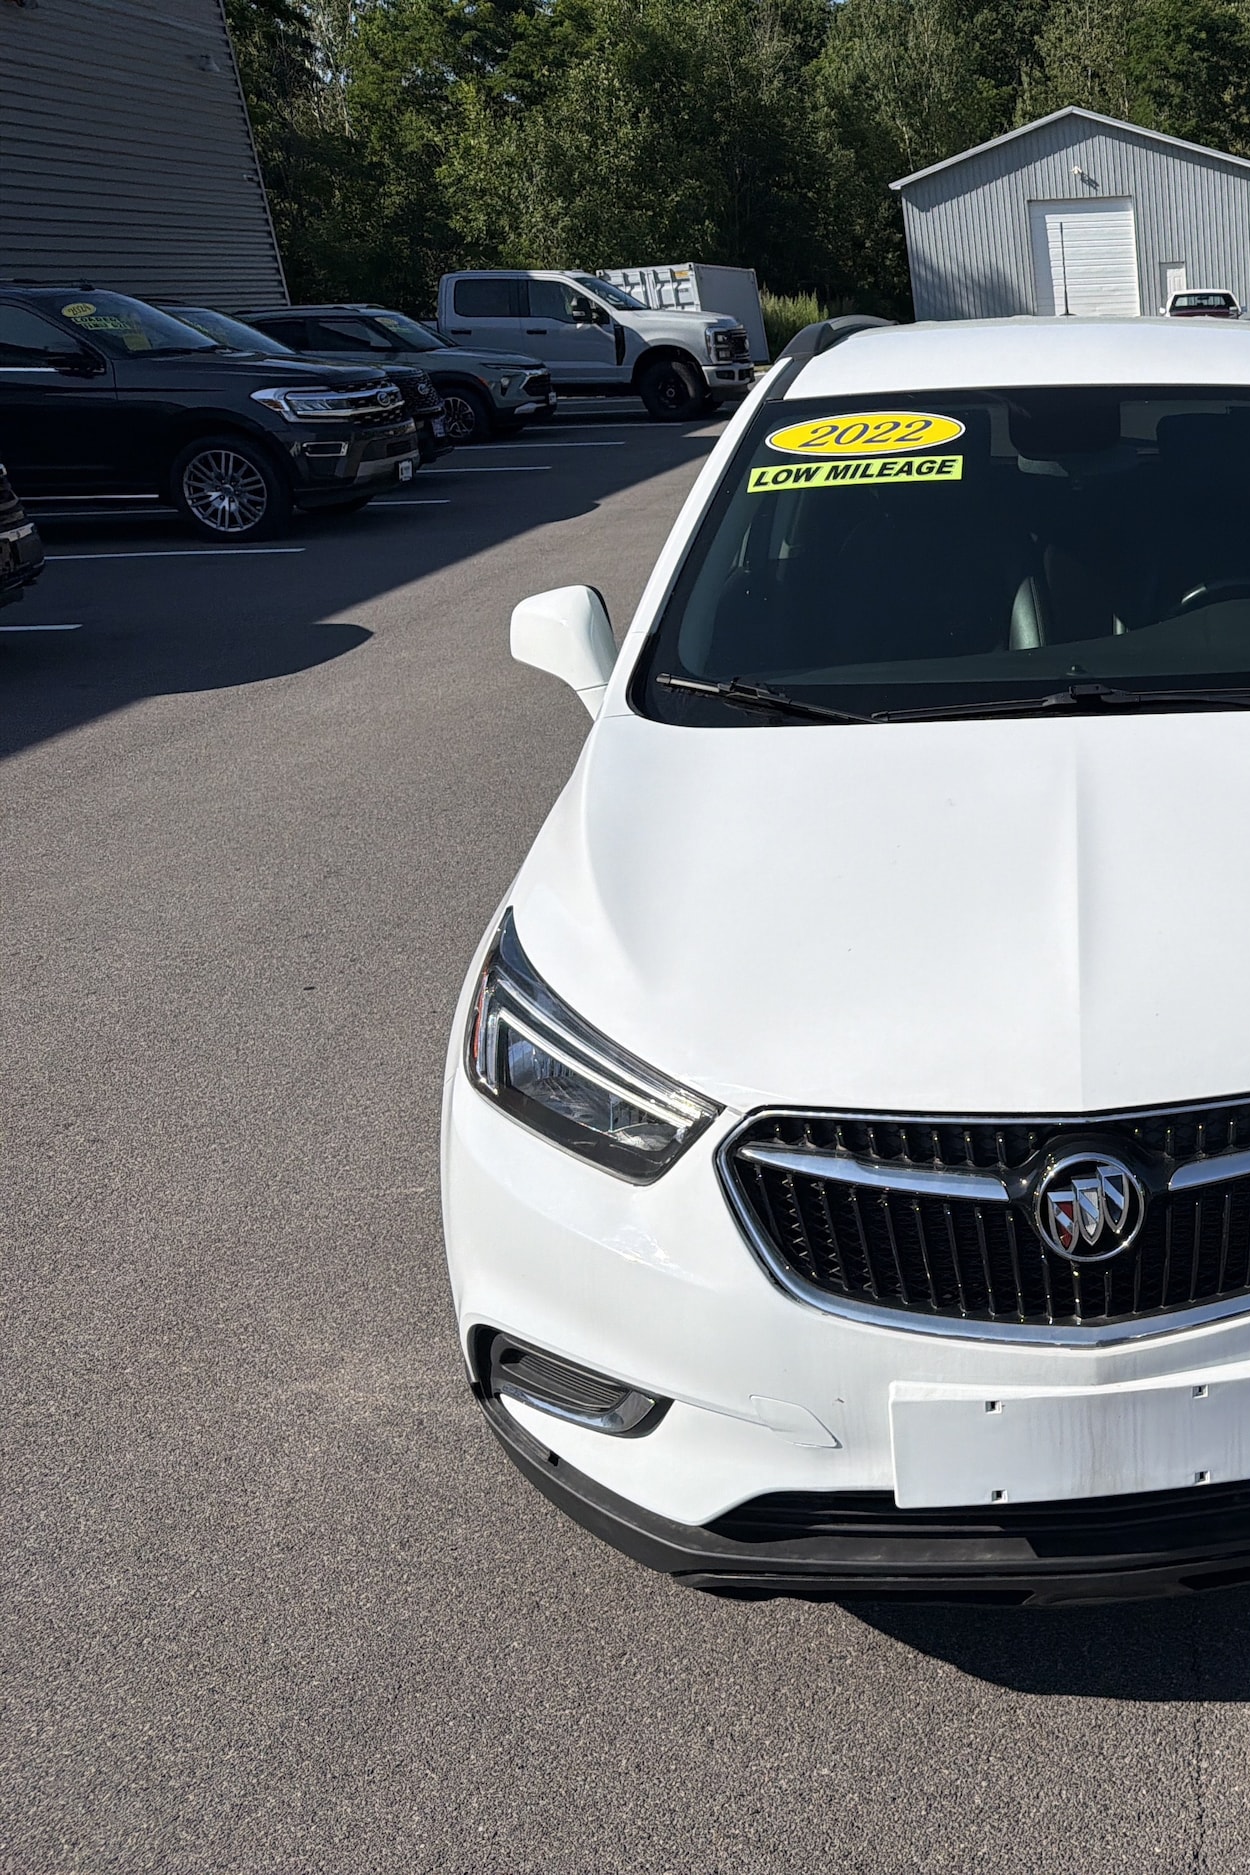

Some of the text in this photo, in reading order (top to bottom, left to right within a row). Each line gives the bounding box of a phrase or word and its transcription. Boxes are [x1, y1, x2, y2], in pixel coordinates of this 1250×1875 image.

[799, 419, 933, 448] 2022
[754, 458, 958, 488] LOW MILEAGE
